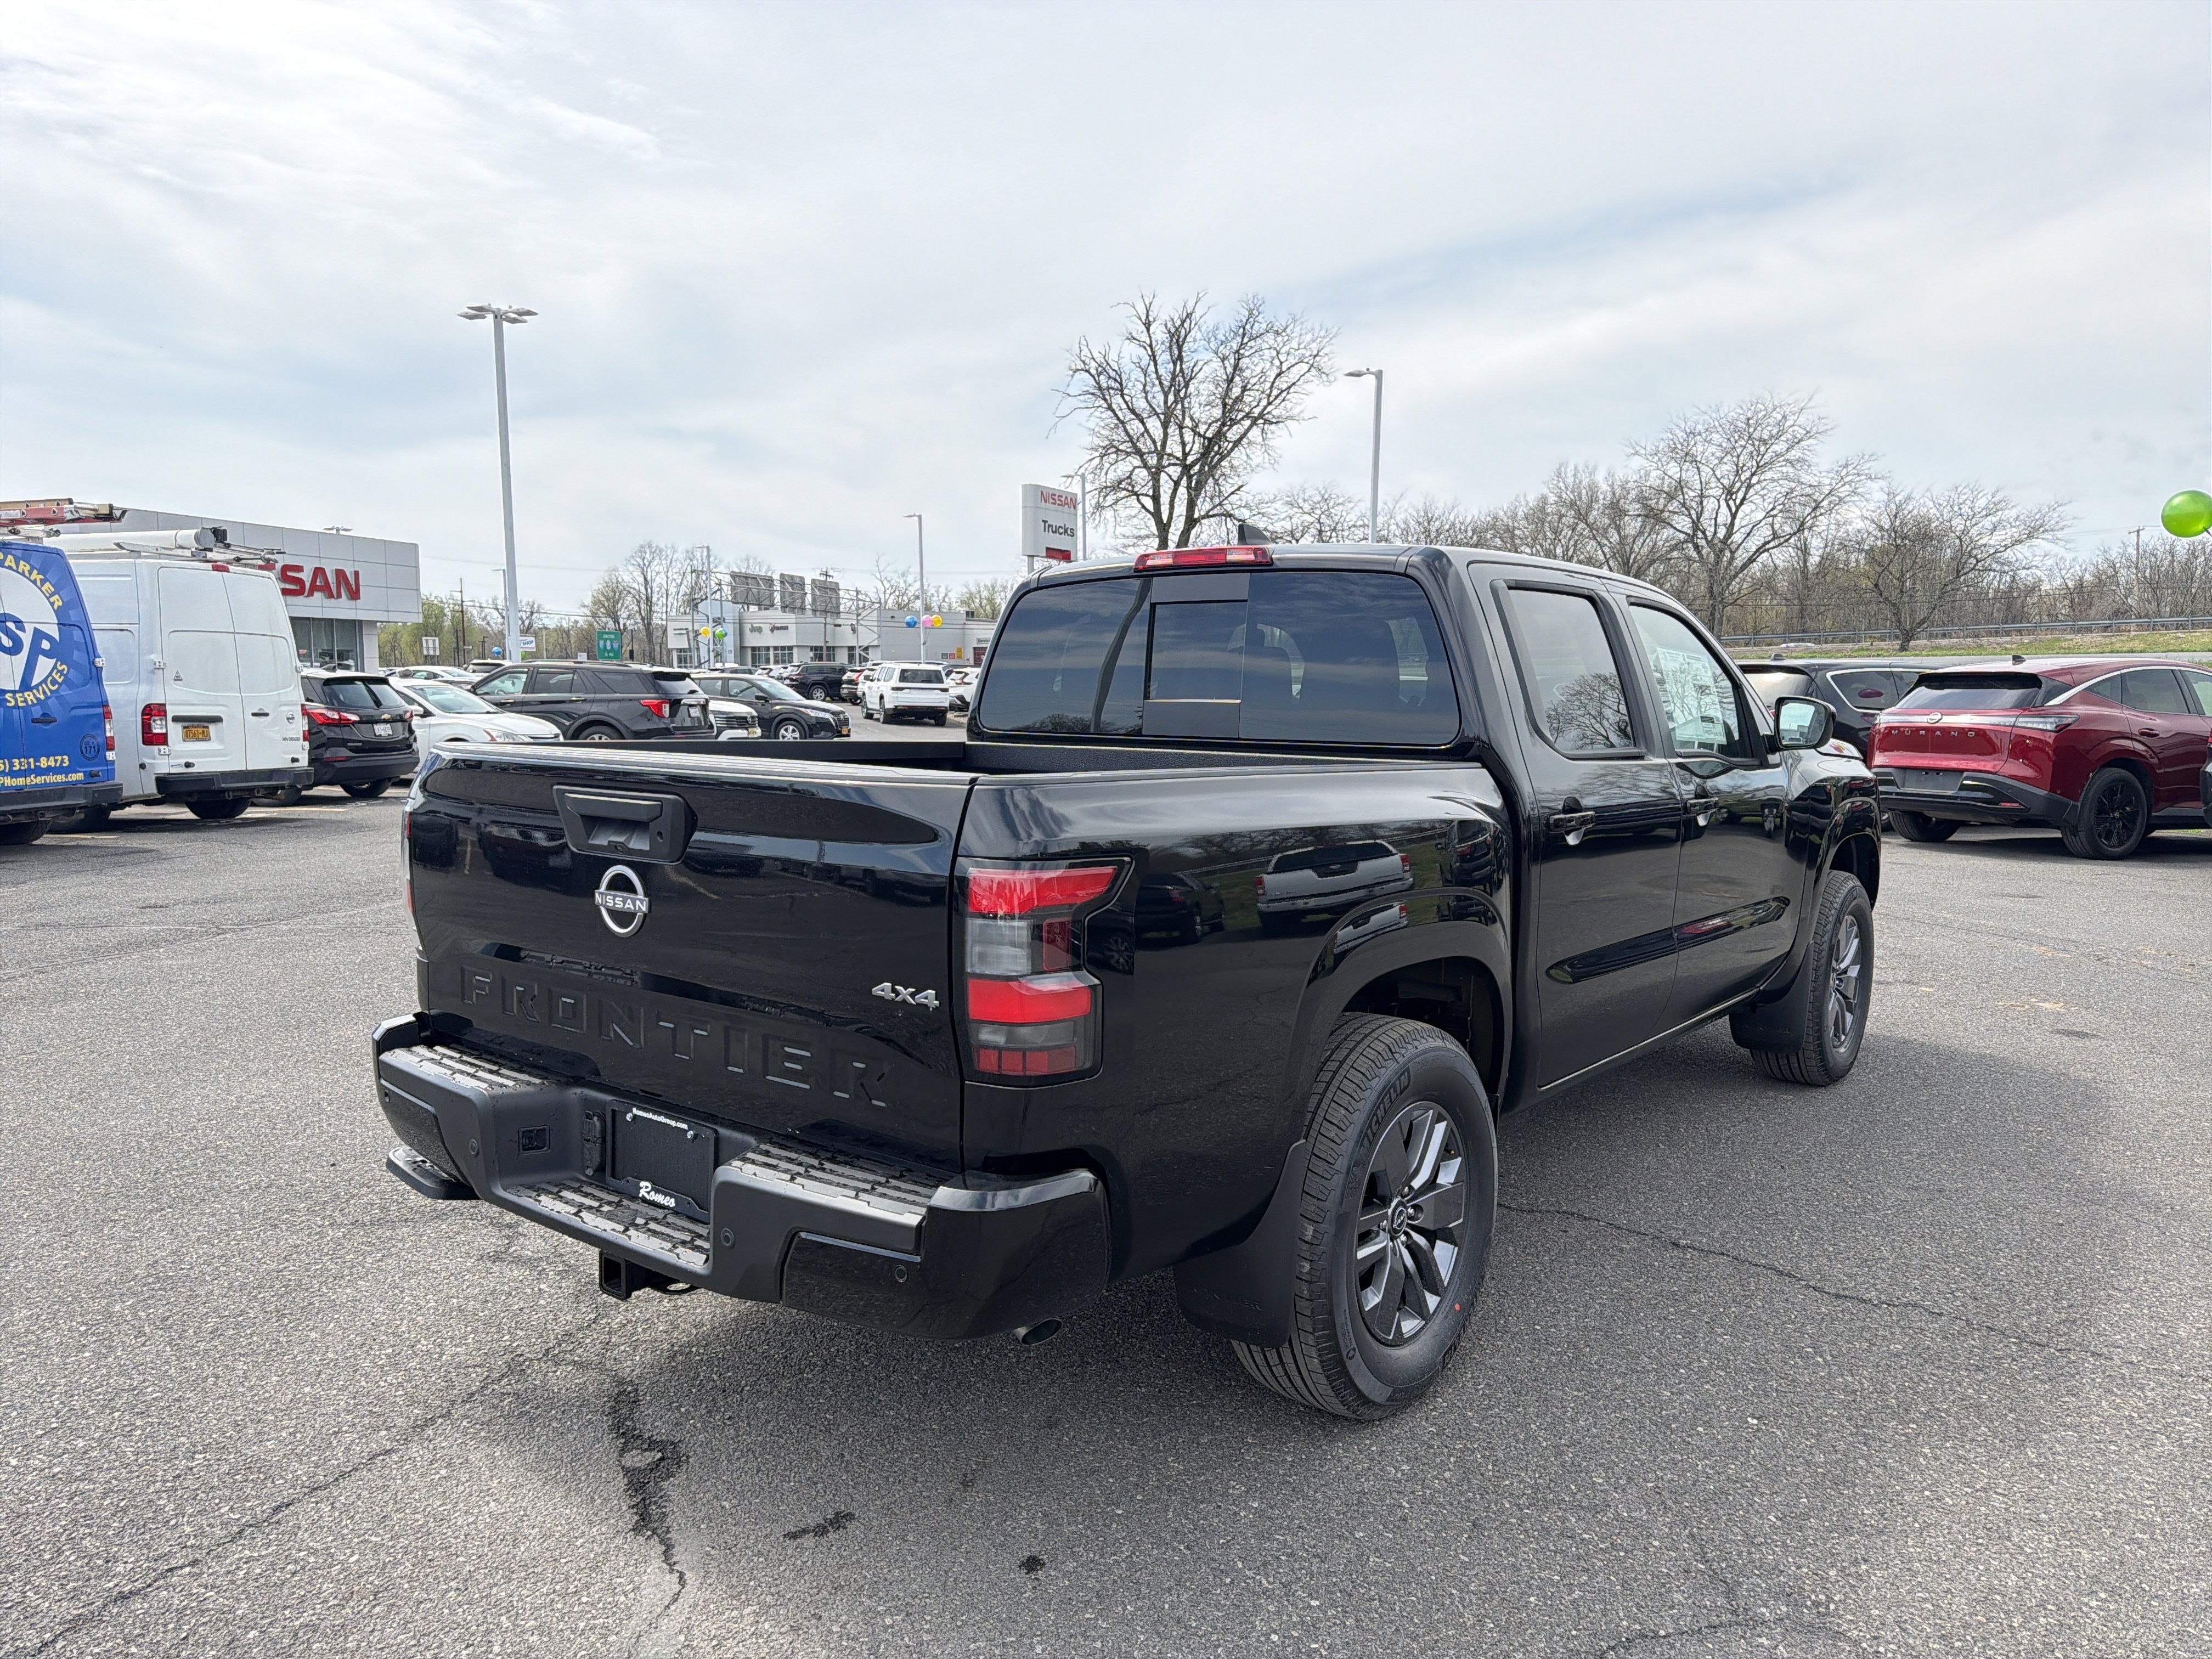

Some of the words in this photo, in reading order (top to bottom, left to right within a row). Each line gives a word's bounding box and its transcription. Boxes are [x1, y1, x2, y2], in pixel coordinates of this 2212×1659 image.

[1040, 490, 1076, 510] NISSAN
[1042, 520, 1075, 537] Trucks
[0, 552, 63, 610] ARKER
[257, 563, 360, 600] SAN
[5, 661, 67, 707] SERVICES
[84, 745, 96, 754] 171
[12, 755, 69, 770] 331-8473
[596, 893, 646, 911] NISSAN
[460, 964, 891, 1108] FRONTIER
[633, 1108, 689, 1130] RomeoAutoGroup.com
[1359, 1070, 1410, 1160] MICHELIN
[639, 1181, 676, 1207] Romeo
